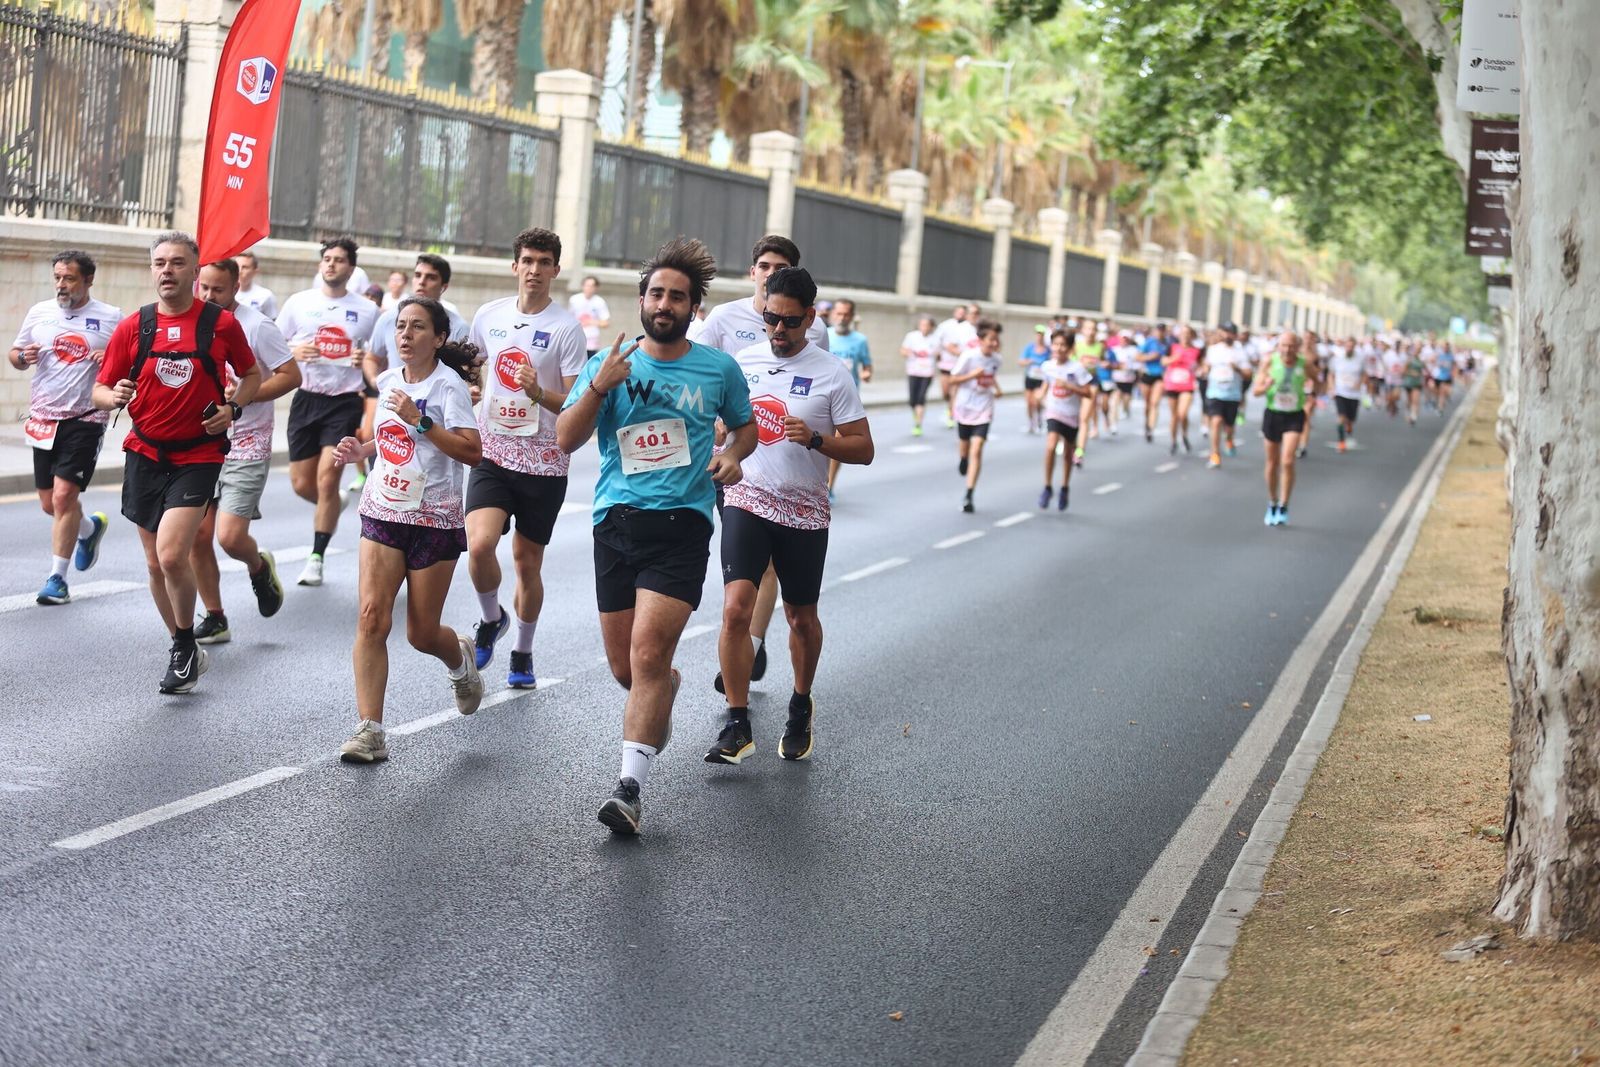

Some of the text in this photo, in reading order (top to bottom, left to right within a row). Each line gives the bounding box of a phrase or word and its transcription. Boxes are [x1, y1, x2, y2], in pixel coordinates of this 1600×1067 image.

[222, 132, 257, 169] 55
[226, 174, 244, 191] MIN
[58, 338, 86, 352] PONLE
[162, 360, 189, 372] PONLE
[499, 364, 516, 377] FRE
[501, 356, 521, 370] PON
[160, 366, 187, 379] FRENO
[500, 406, 527, 417] 356
[752, 404, 785, 426] PONLE
[754, 414, 782, 435] RENO
[380, 439, 408, 457] FRENO
[635, 432, 670, 449] 401
[383, 474, 411, 492] 487
